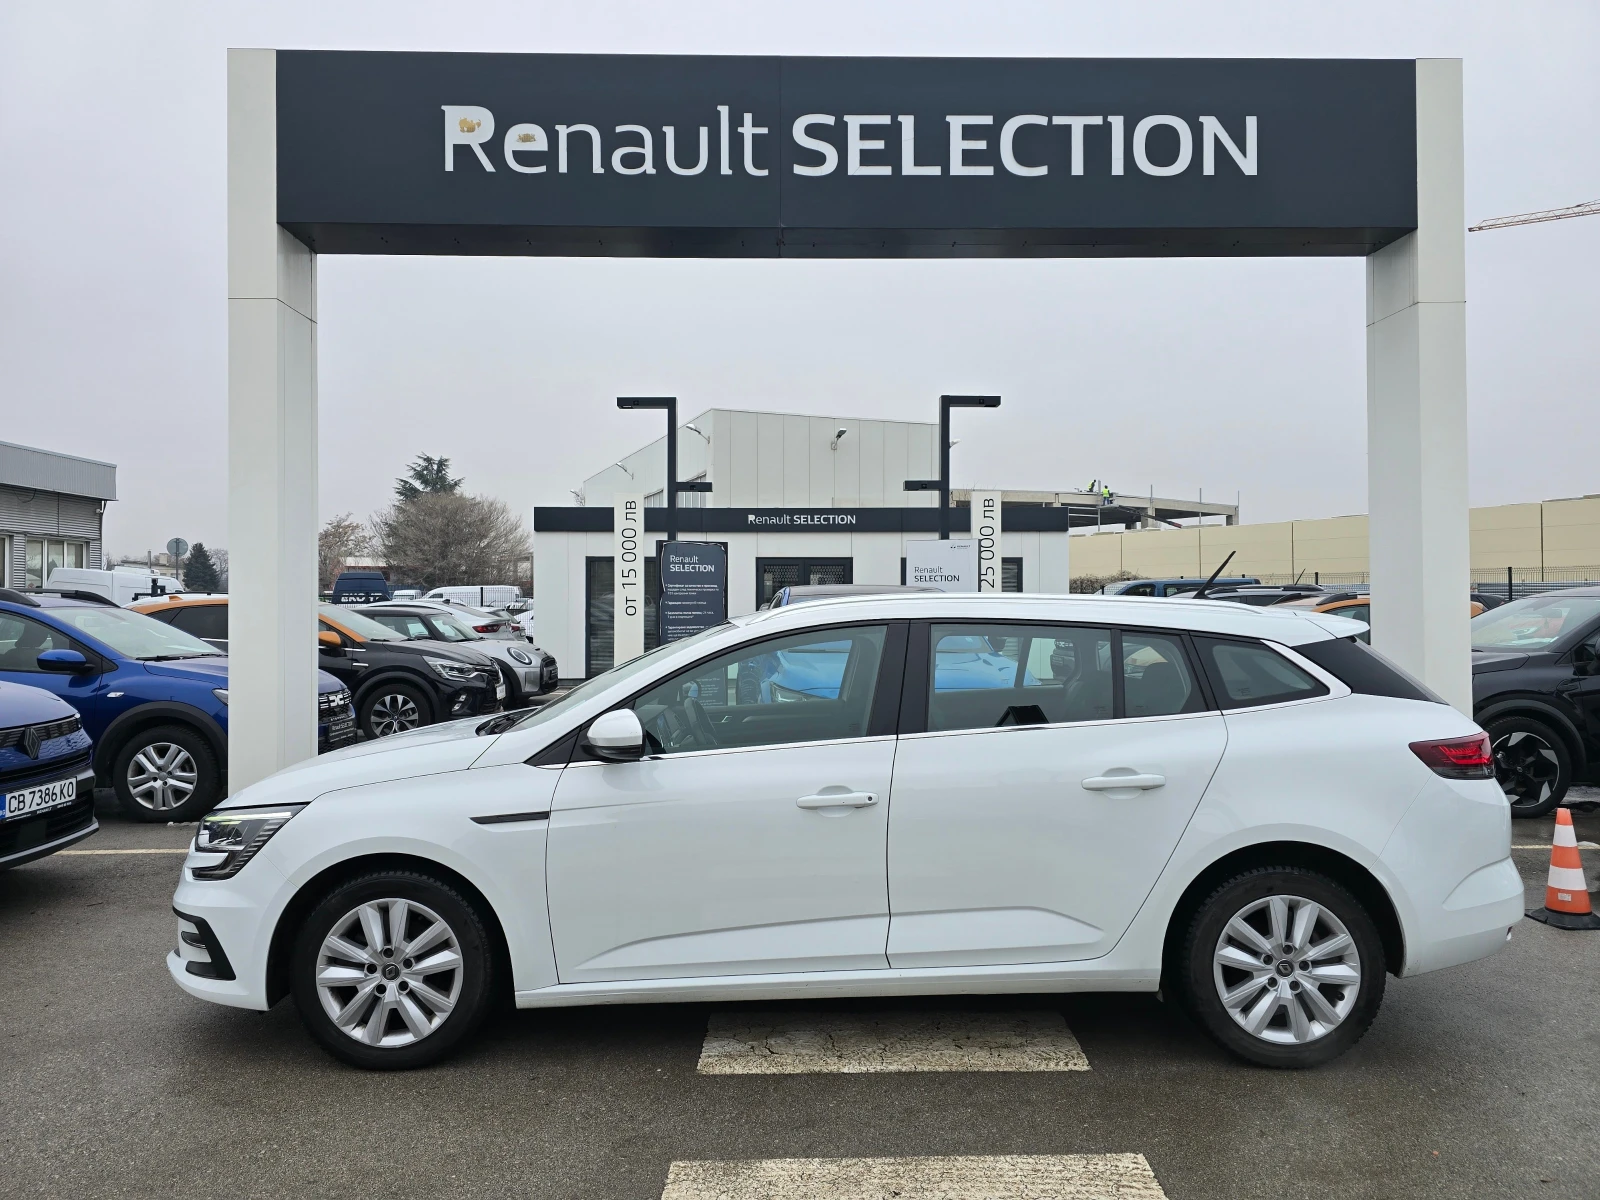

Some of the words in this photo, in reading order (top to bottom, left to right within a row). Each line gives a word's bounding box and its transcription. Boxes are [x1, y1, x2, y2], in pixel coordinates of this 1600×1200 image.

[441, 105, 769, 177] Renault
[793, 114, 1257, 176] SELECTION
[747, 514, 791, 525] Renault
[793, 514, 856, 525] SELECTION
[622, 527, 637, 563] 000
[979, 525, 995, 561] 000
[669, 555, 699, 563] Renault
[669, 564, 715, 573] SELECTION
[914, 565, 943, 574] Renault
[622, 568, 637, 590] 15
[914, 574, 960, 583] SELECTION
[980, 566, 995, 588] 25
[8, 793, 26, 813] CB
[28, 785, 58, 809] 7386
[59, 781, 74, 801] KO
